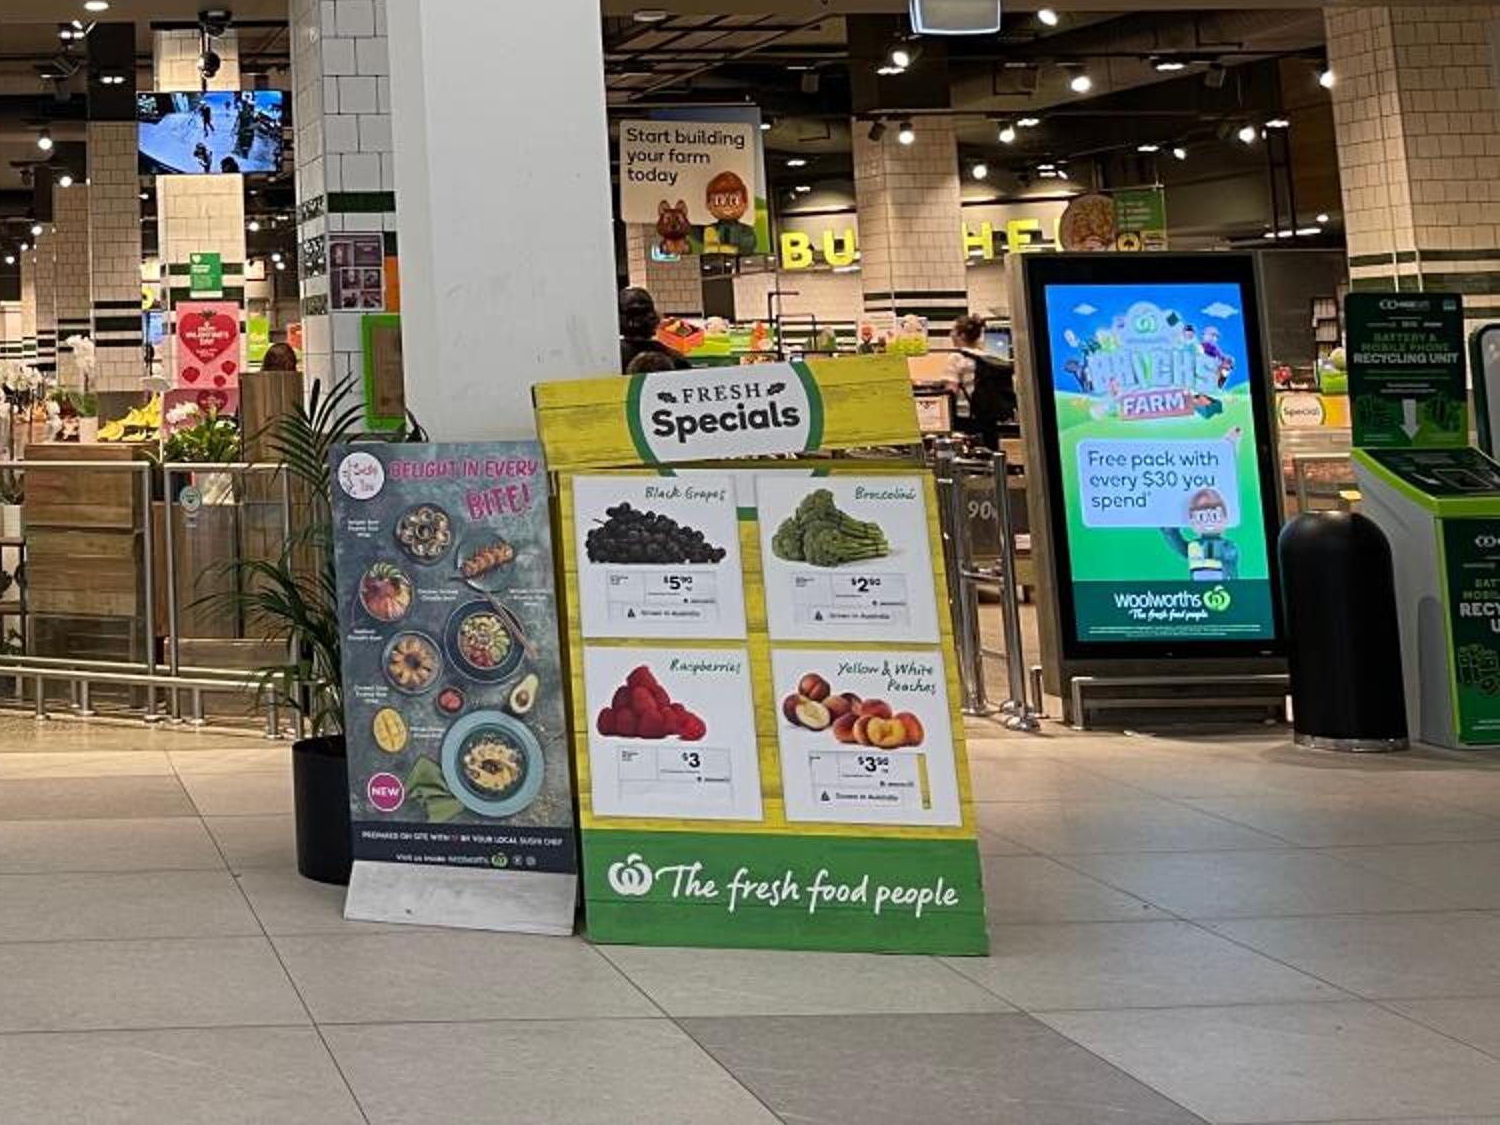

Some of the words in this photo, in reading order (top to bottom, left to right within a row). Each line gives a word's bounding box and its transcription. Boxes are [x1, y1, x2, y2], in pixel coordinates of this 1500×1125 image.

[627, 128, 670, 143] Start
[675, 129, 745, 150] building
[627, 150, 664, 165] your
[668, 149, 711, 163] farm
[627, 167, 678, 186] today
[1353, 353, 1427, 364] RECYCLING
[1429, 353, 1459, 364] UNIT
[682, 383, 762, 403] FRESH
[1123, 392, 1185, 416] FARM
[651, 400, 801, 443] Specials
[388, 459, 456, 479] DELIGHT
[463, 459, 479, 475] IN
[485, 459, 538, 476] EVERY
[1088, 451, 1127, 467] Free
[1131, 451, 1175, 471] pack
[1180, 450, 1219, 466] with
[1090, 476, 1137, 491] every
[1143, 471, 1178, 487] $30
[1183, 476, 1215, 491] you
[466, 482, 531, 521] BITE!
[645, 486, 681, 499] Black
[685, 486, 726, 503] Grapes
[1128, 608, 1147, 619] The
[670, 659, 741, 675] Raspberries
[838, 661, 879, 675] Yellow
[895, 659, 933, 675] White
[887, 678, 937, 695] Peaches
[682, 752, 701, 768] $3
[371, 786, 400, 796] NEW
[494, 836, 517, 844] LOCAL
[655, 863, 718, 898] The
[726, 867, 799, 913] fresh
[806, 869, 868, 914] food
[875, 877, 959, 918] people
